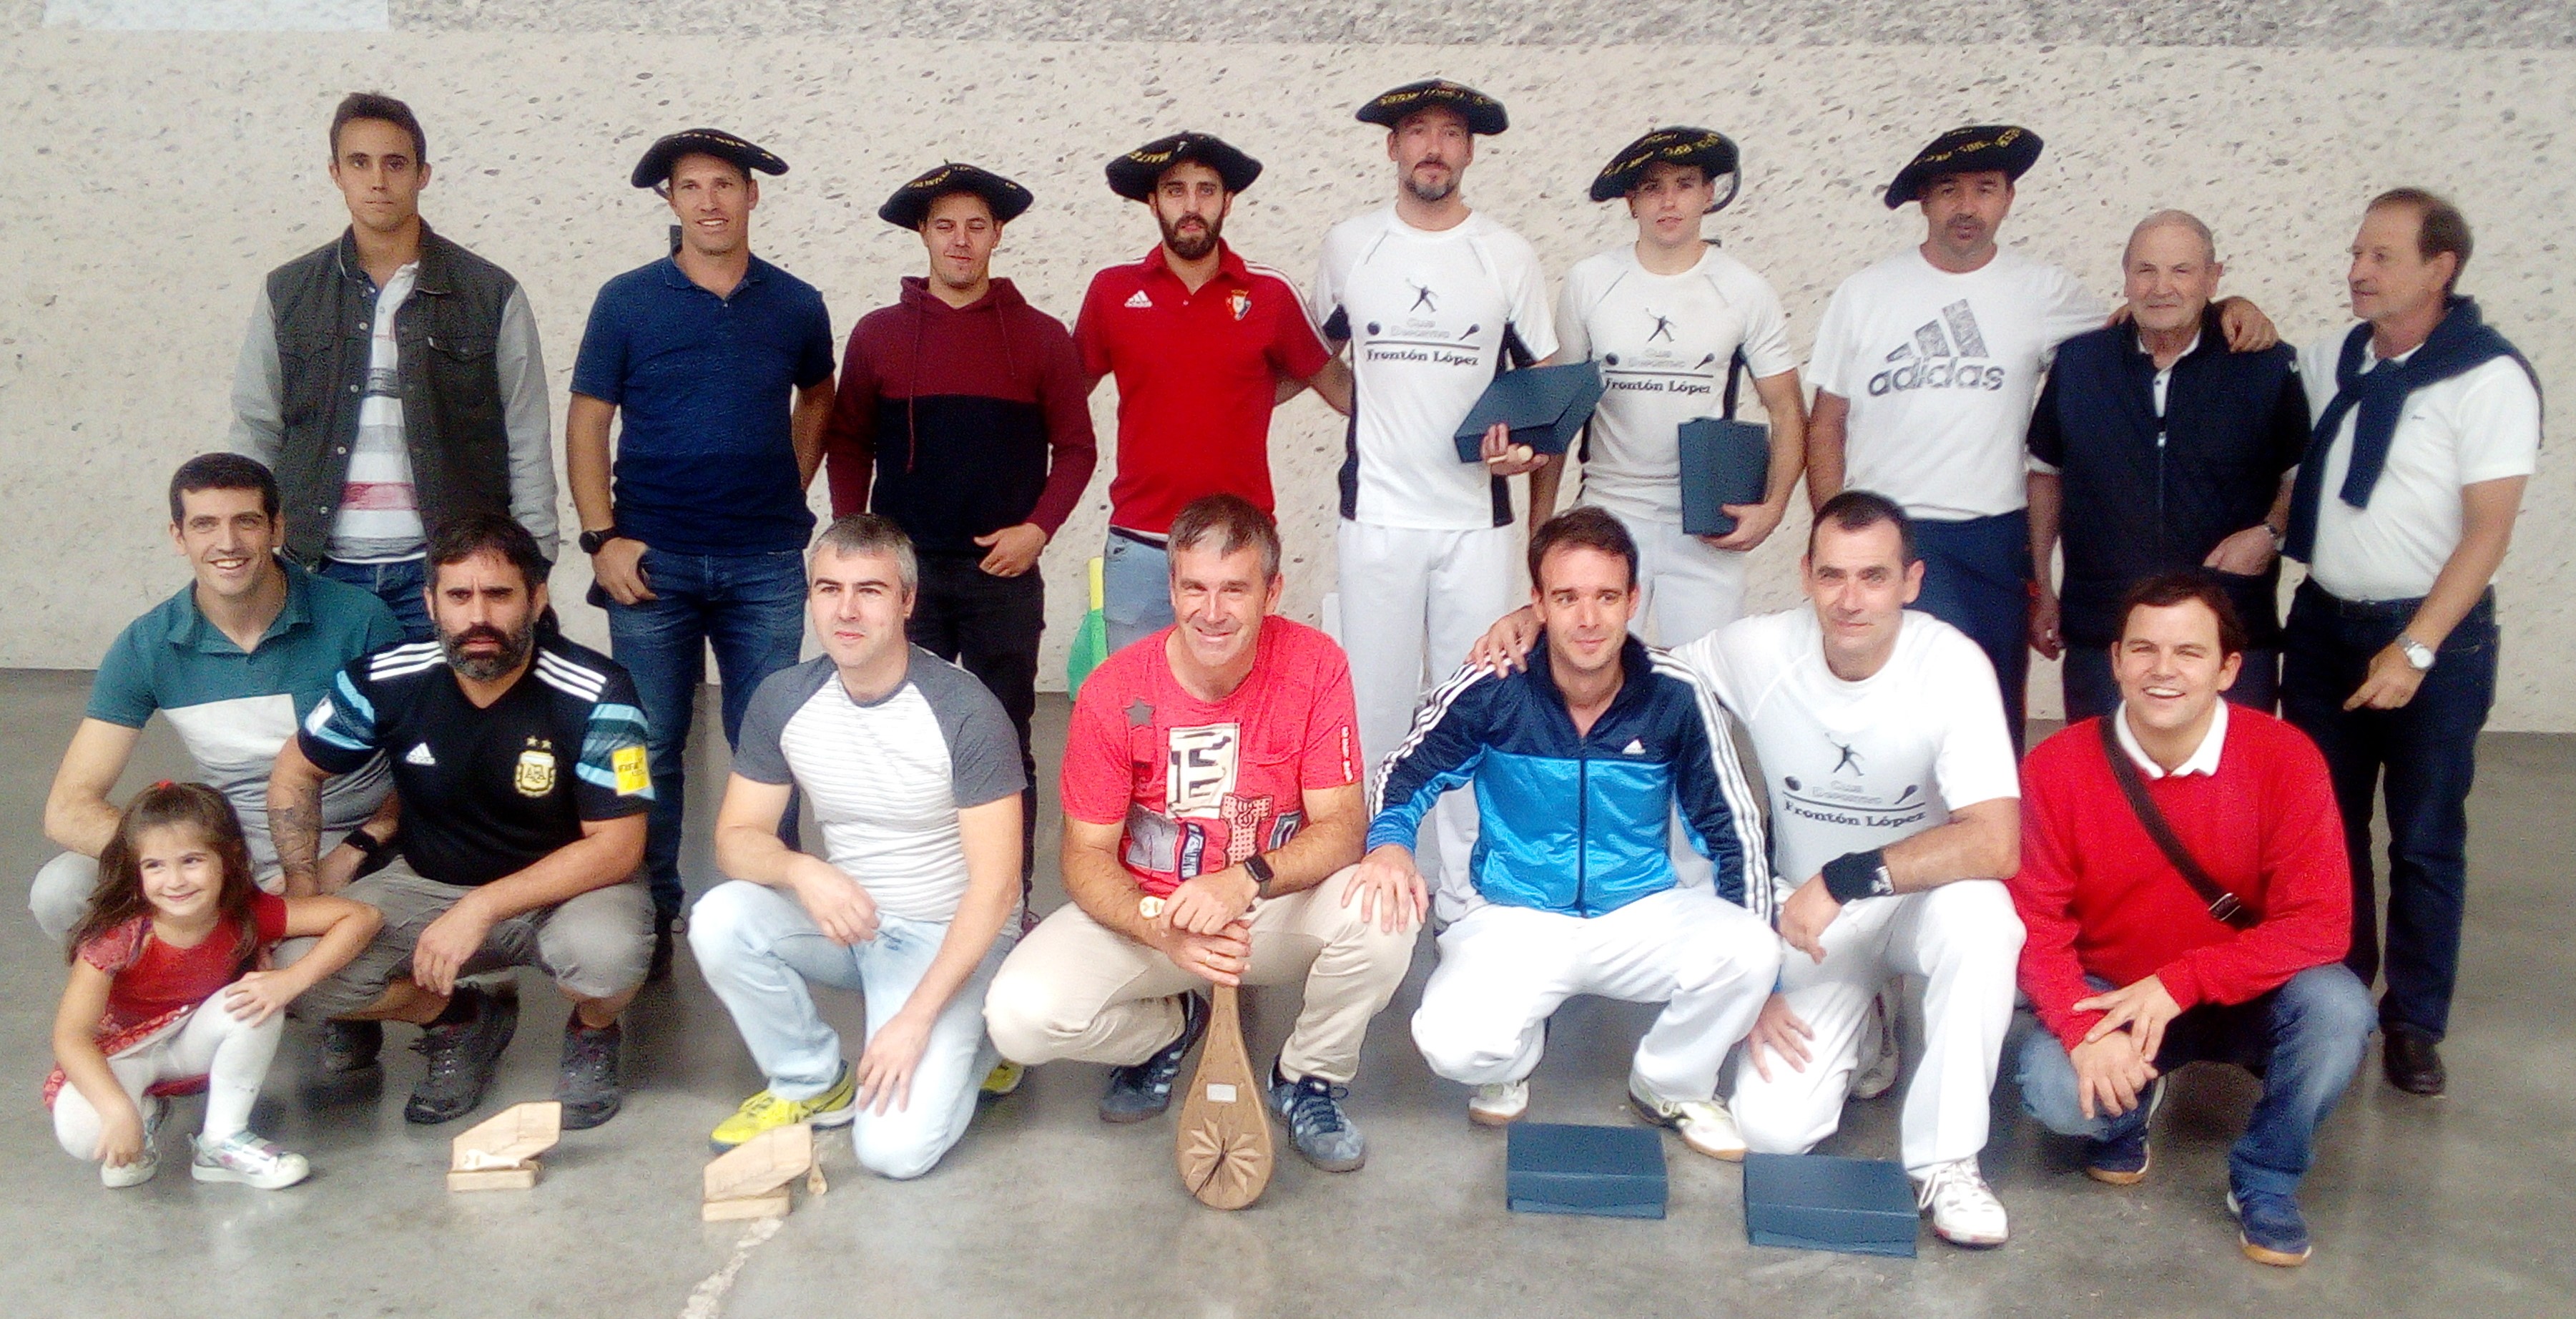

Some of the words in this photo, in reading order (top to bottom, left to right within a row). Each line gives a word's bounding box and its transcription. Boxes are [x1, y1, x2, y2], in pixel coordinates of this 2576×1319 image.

[1366, 348, 1428, 361] Frontón
[1433, 350, 1479, 366] López
[1668, 379, 1711, 396] López
[1868, 356, 2005, 398] adidas
[1784, 798, 1861, 825] Frontón
[1867, 811, 1926, 829] López
